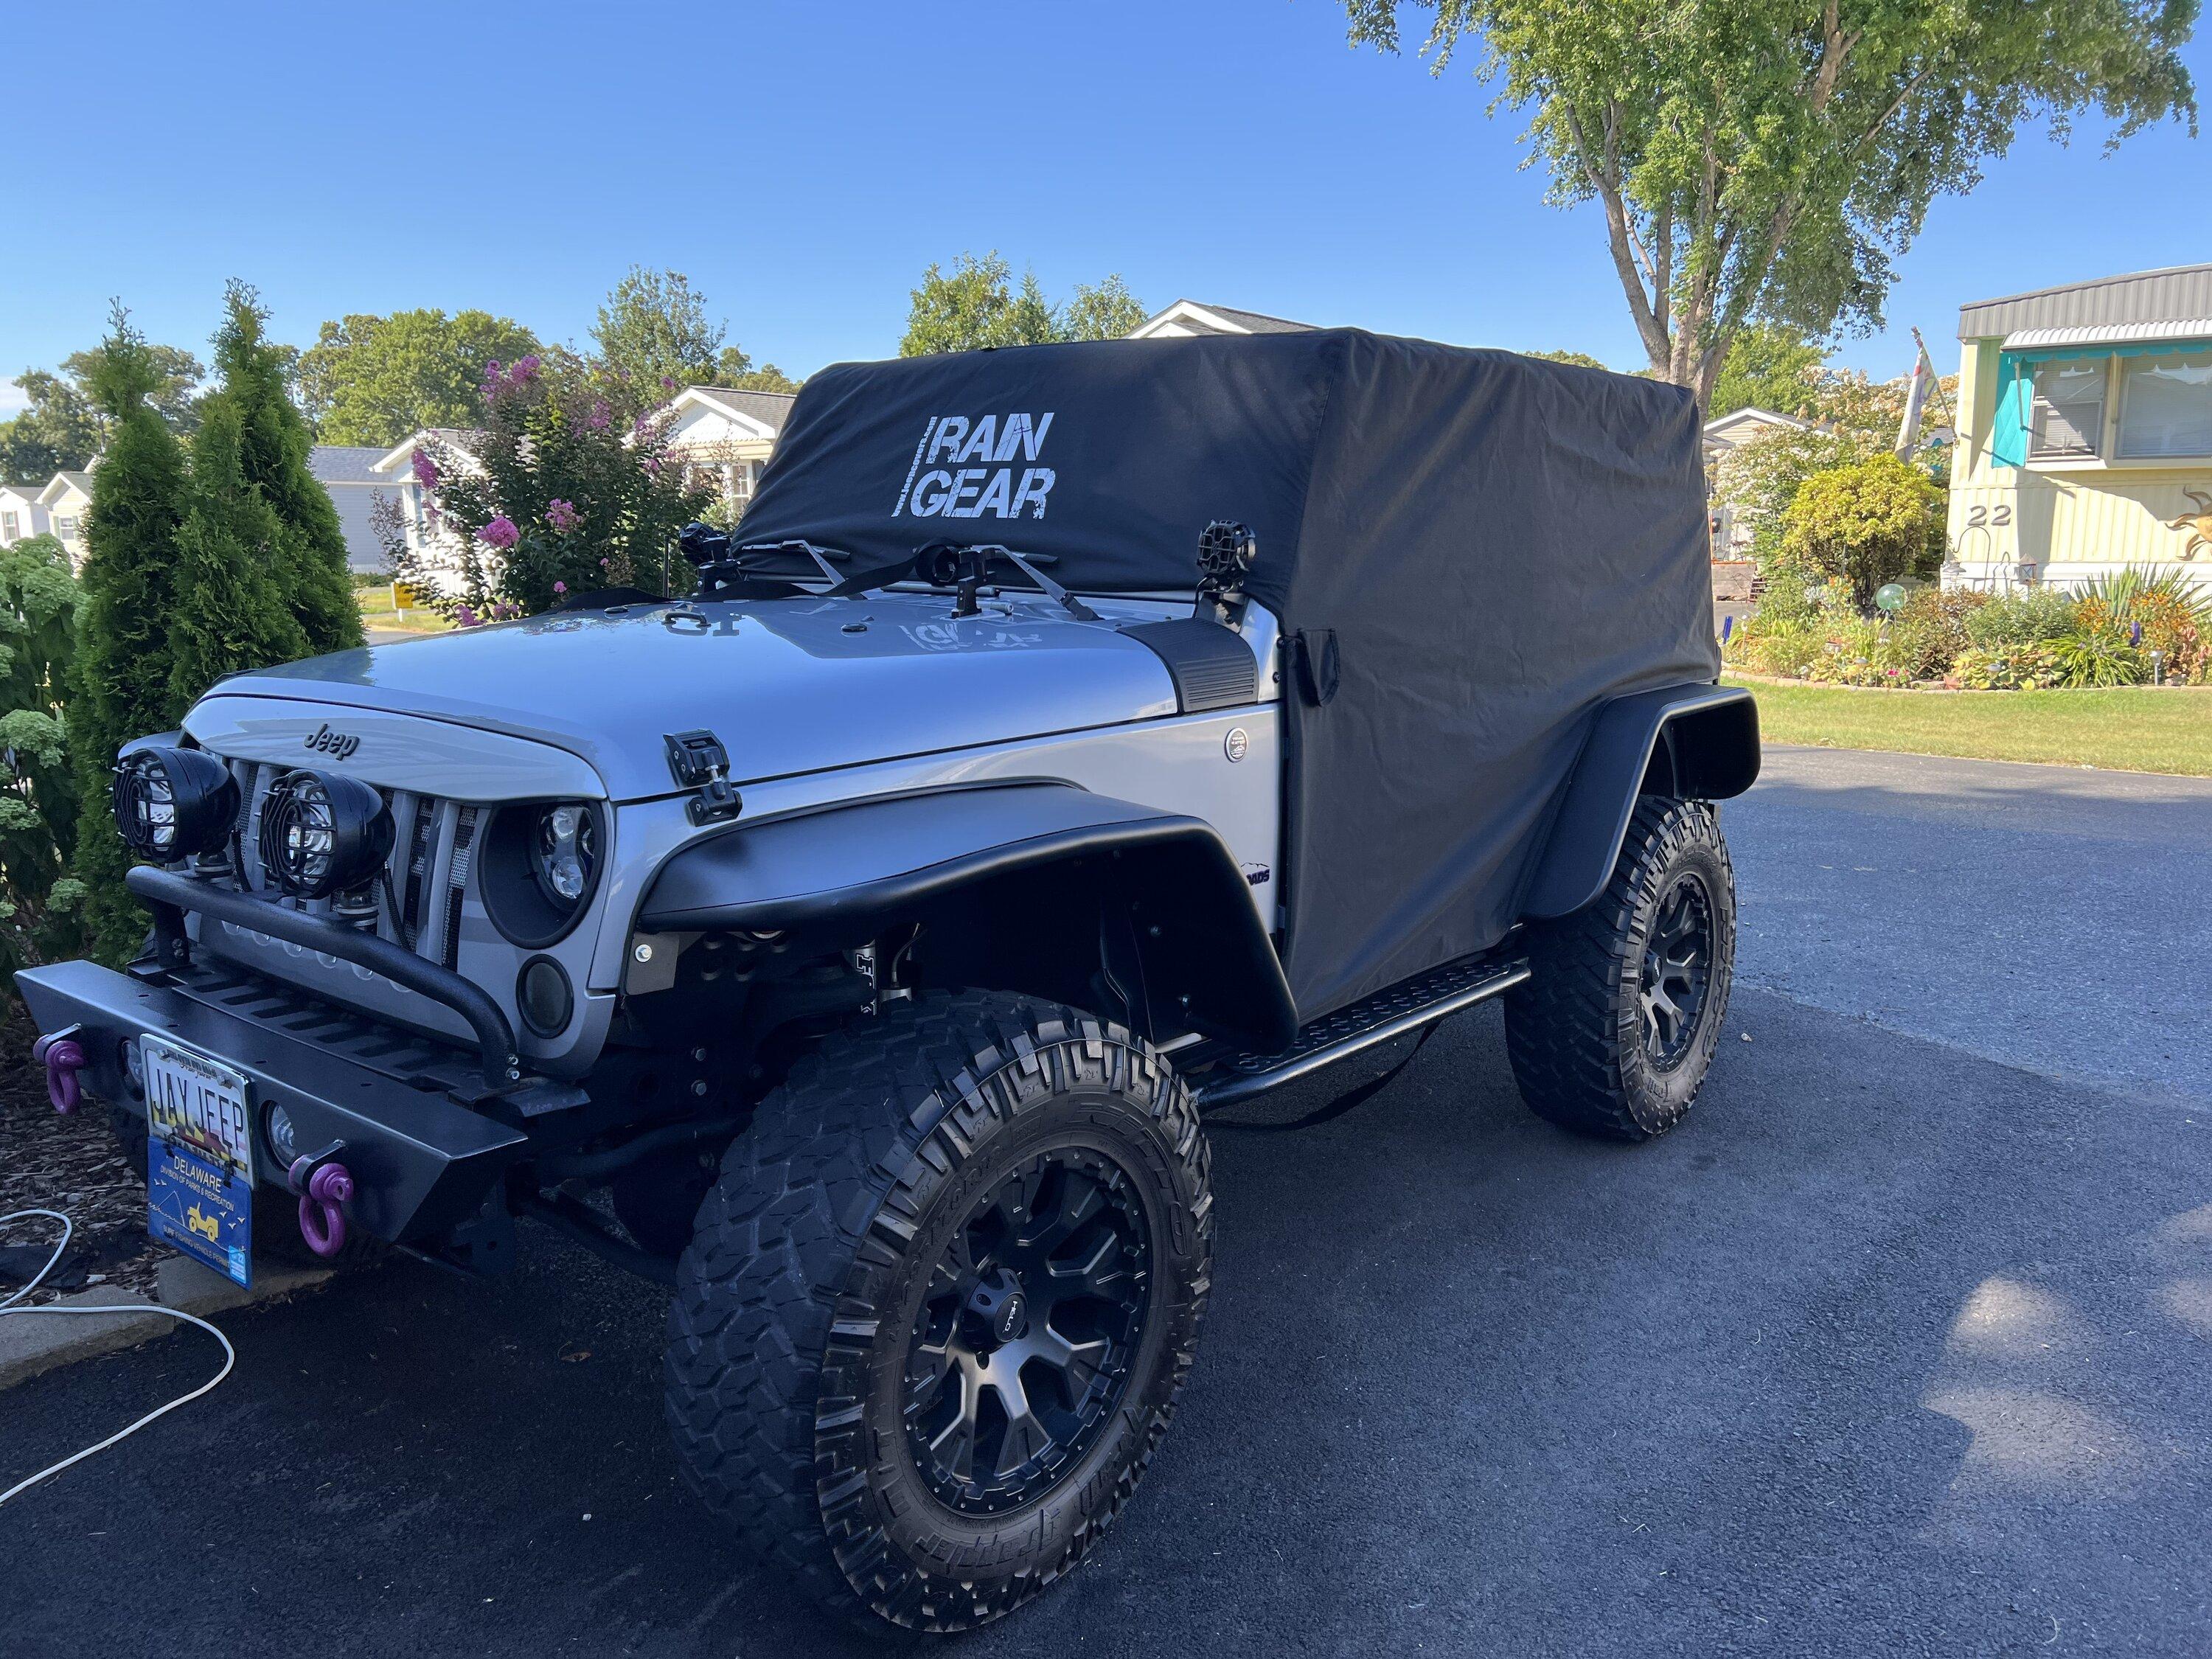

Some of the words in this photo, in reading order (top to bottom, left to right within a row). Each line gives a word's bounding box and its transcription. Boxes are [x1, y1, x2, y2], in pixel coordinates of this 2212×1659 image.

[925, 412, 1055, 465] RAIN
[910, 467, 1056, 519] GEAR
[1967, 504, 2011, 526] 22
[303, 723, 360, 762] Jeep
[160, 1164, 178, 1182] DIVISION
[178, 1174, 185, 1185] OF
[185, 1178, 200, 1193] PARKS
[204, 1189, 234, 1211] RECREATION
[174, 1155, 221, 1193] DELAWARE
